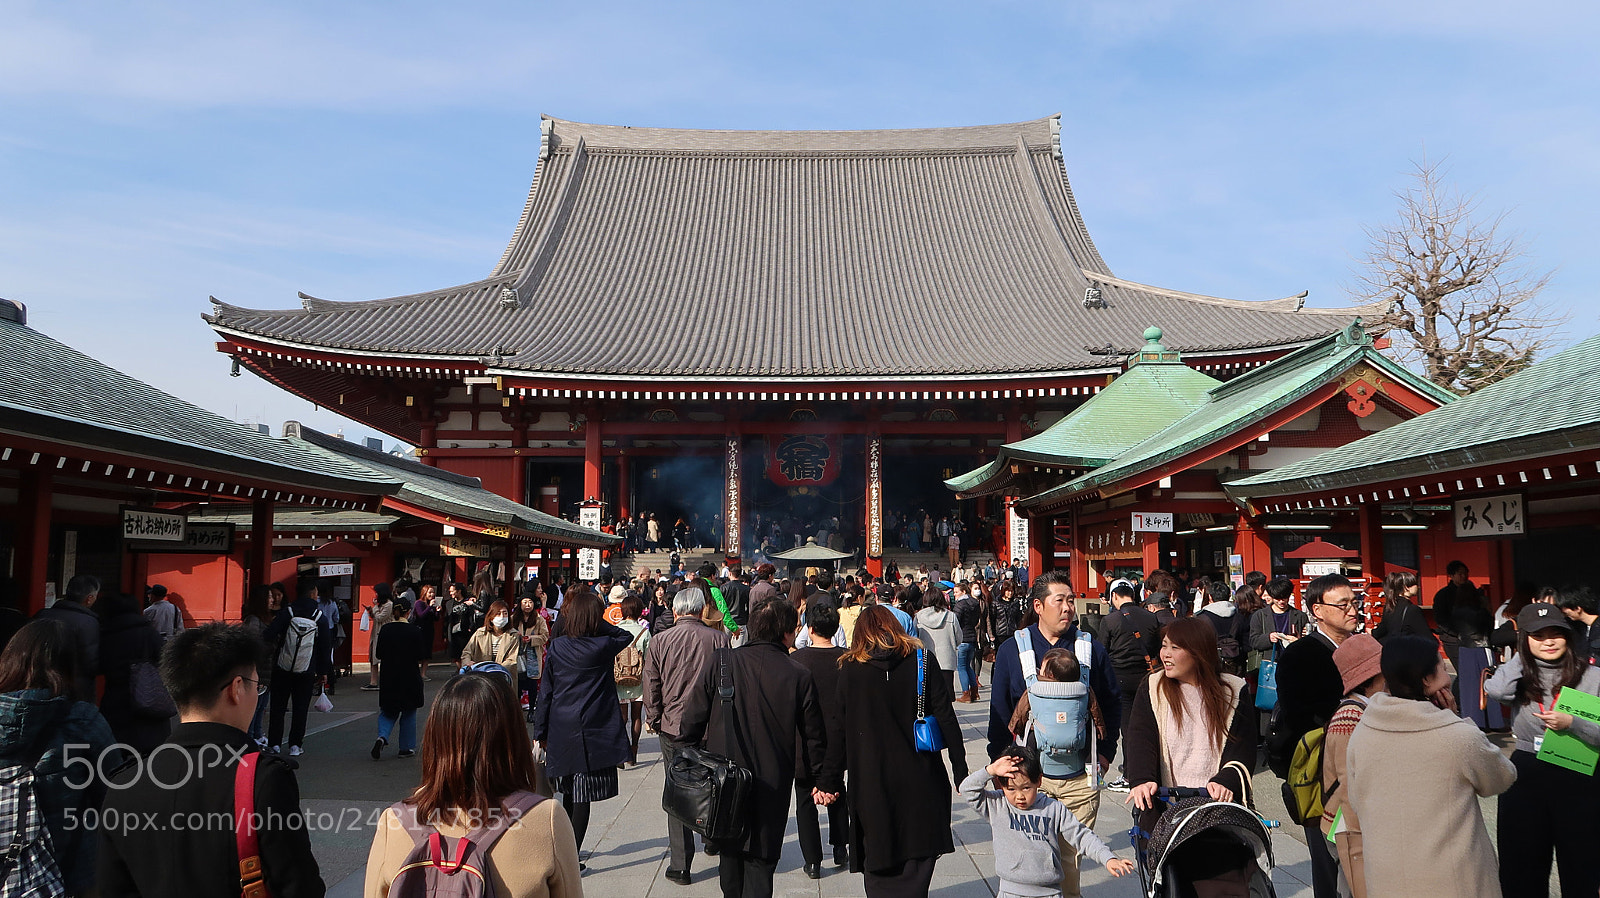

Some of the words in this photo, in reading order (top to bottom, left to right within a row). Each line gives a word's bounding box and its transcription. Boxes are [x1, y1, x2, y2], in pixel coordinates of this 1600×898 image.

[125, 514, 181, 537] 古札お納め所
[1462, 501, 1517, 530] みくじ
[1497, 521, 1520, 532] 百円
[1010, 812, 1051, 836] NAVY
